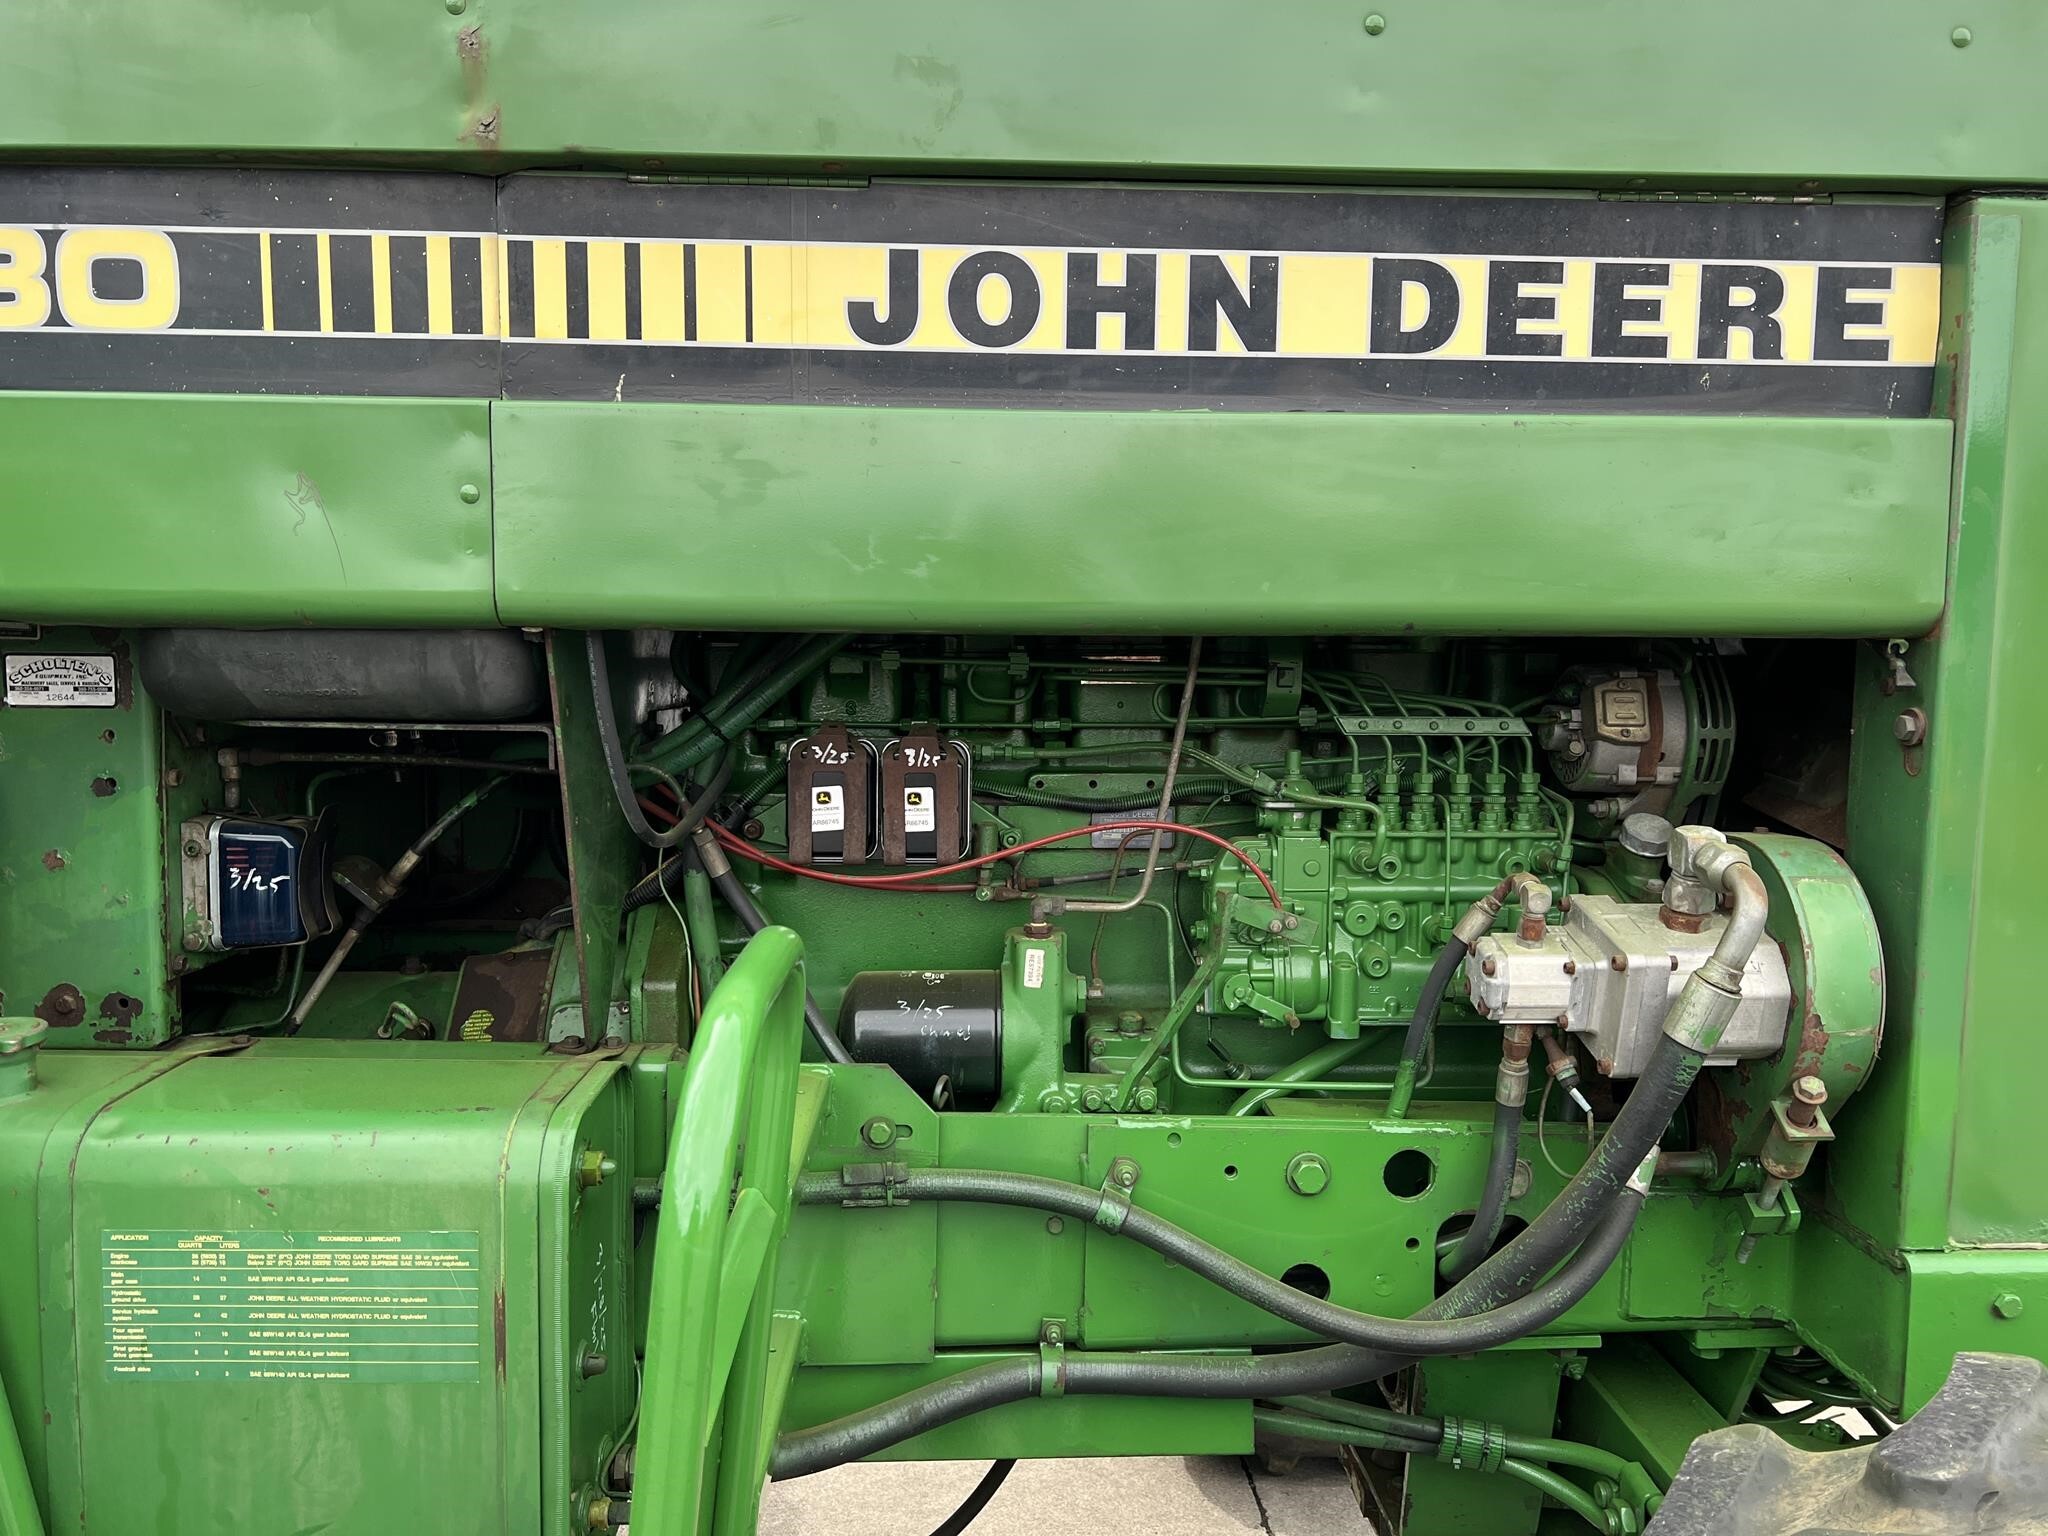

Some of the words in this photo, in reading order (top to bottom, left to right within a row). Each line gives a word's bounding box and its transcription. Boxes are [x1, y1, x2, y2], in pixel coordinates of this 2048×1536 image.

[845, 246, 1280, 353] JOHN
[1368, 255, 1894, 362] DEERE
[9, 658, 112, 685] SCHOLTEN'S
[811, 743, 849, 764] 3/25
[905, 747, 941, 767] 3/25
[230, 868, 290, 893] 3/25
[896, 999, 954, 1022] 3/25
